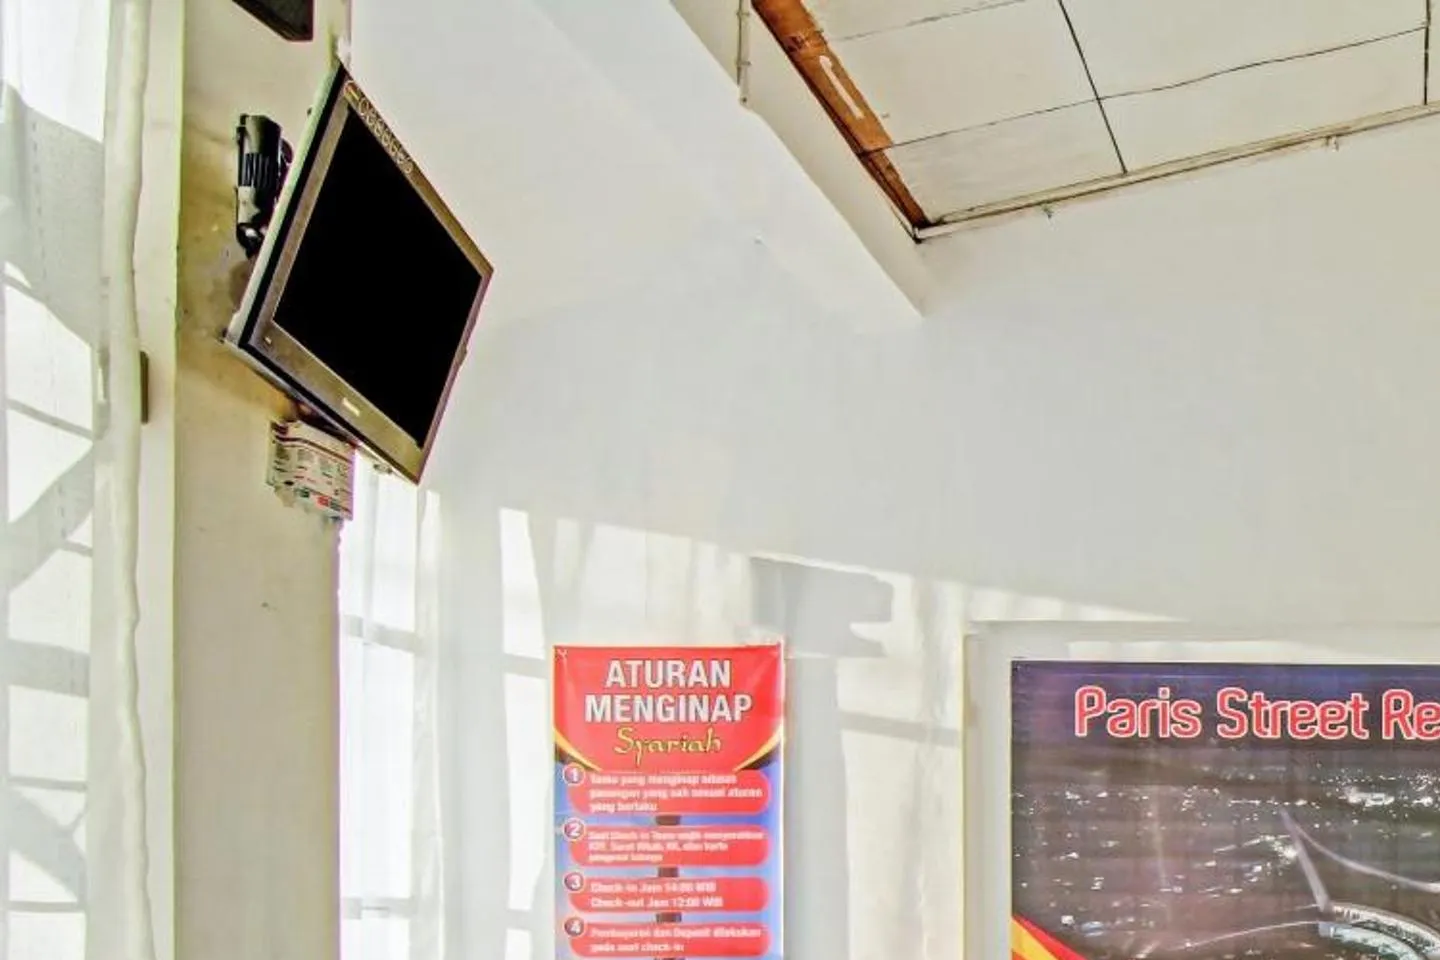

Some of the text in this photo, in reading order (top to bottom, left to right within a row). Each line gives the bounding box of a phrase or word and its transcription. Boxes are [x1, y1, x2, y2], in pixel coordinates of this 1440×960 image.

[606, 660, 731, 687] ATURAN
[584, 695, 752, 723] MENGINAP
[1075, 686, 1201, 738] Paris
[1217, 687, 1370, 740] Street
[613, 726, 721, 766] Syariah
[570, 769, 579, 782] 1
[621, 776, 646, 787] yang
[648, 774, 700, 787] menginap
[643, 790, 669, 800] yang
[589, 802, 616, 813] yang
[570, 823, 579, 836] 2
[572, 875, 581, 889] 3
[570, 921, 580, 934] 4
